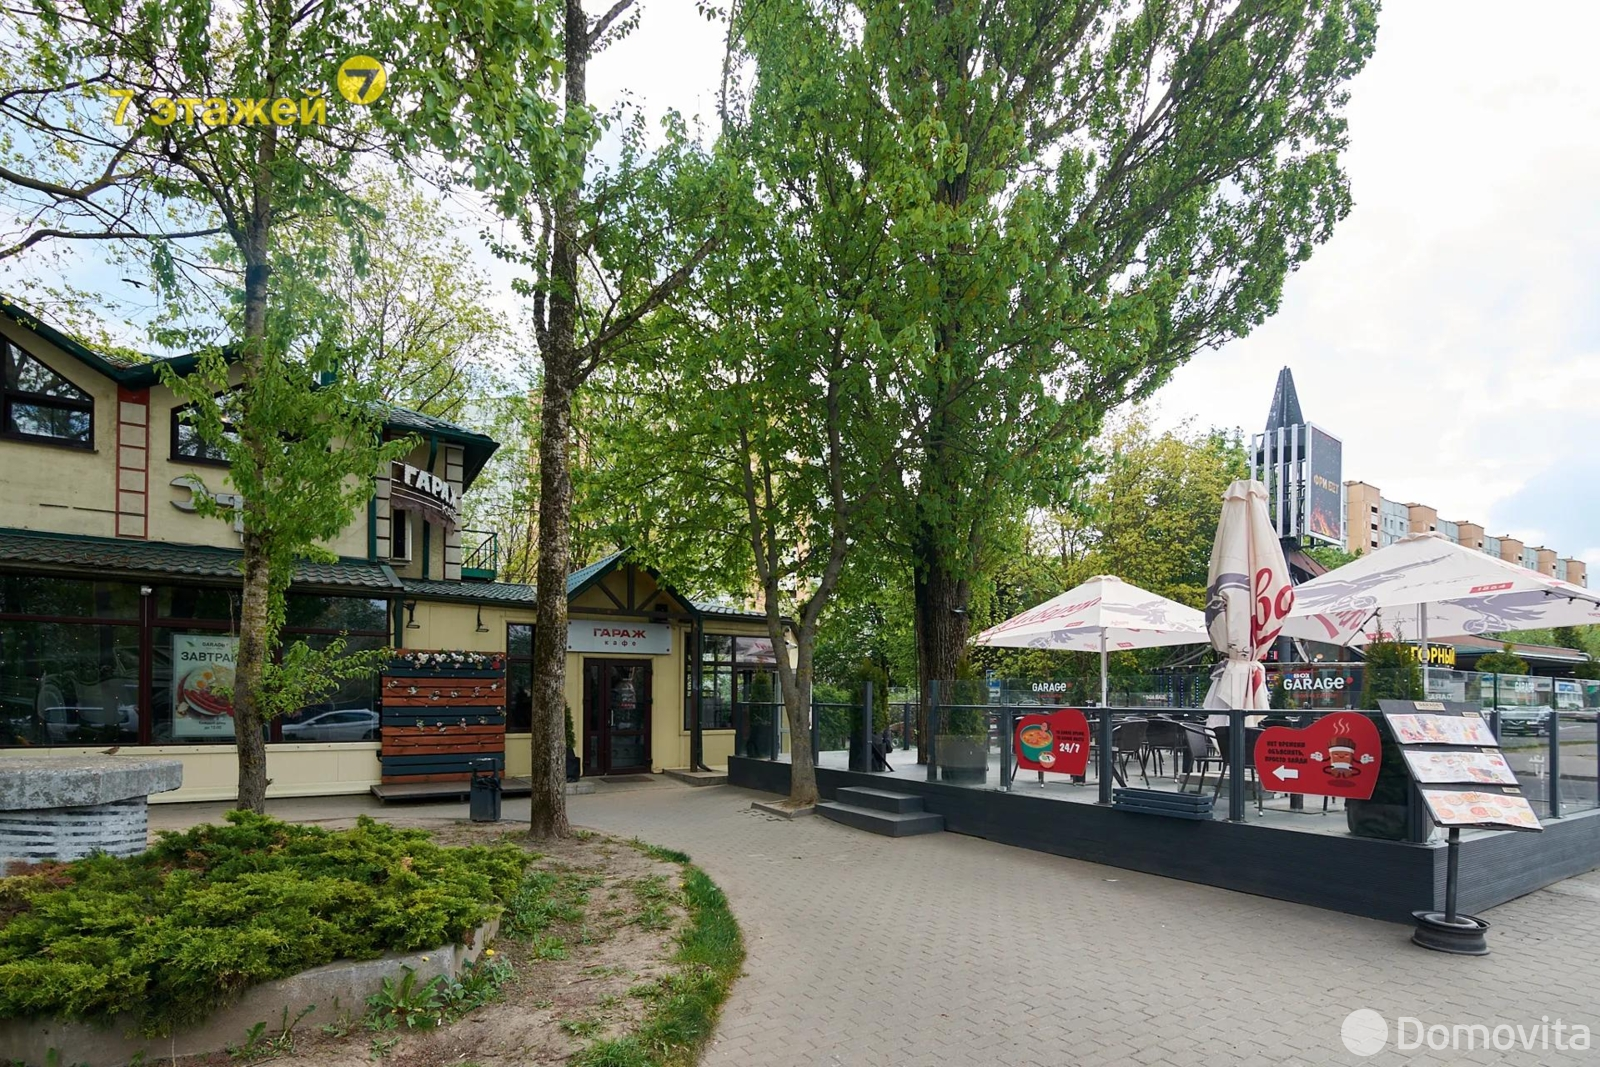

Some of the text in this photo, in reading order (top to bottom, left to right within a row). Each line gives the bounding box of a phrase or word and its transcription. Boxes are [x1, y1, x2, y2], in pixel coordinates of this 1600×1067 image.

[593, 627, 646, 639] ГАРАЖ
[604, 639, 637, 647] кафе
[1059, 742, 1080, 754] 24/7
